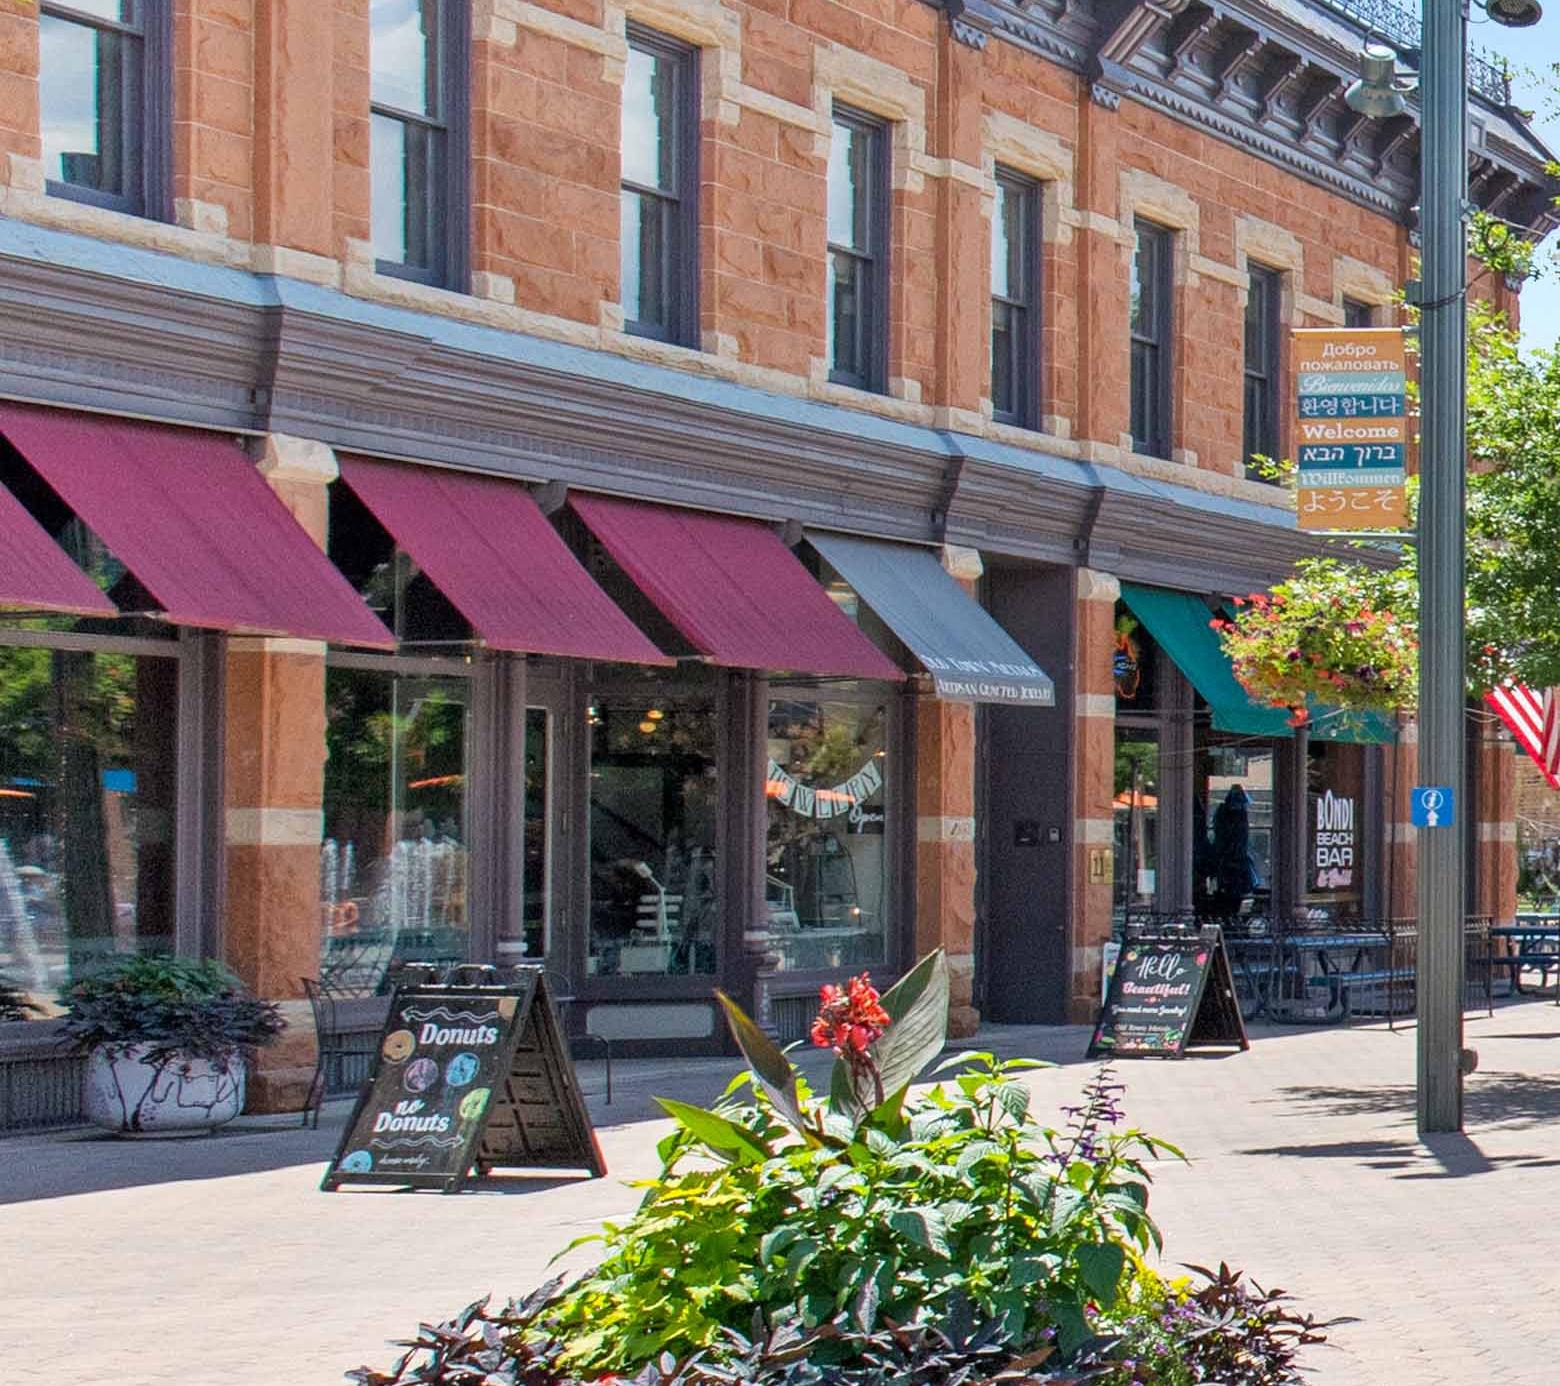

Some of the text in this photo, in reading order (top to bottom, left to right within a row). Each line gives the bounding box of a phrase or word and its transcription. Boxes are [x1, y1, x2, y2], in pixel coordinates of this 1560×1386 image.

[1321, 342, 1376, 358] Добро
[1300, 359, 1399, 371] пожаловать
[1301, 396, 1400, 416] 환영합니다
[1302, 423, 1399, 439] Welcome
[1303, 445, 1396, 467] ברוך הבא
[1303, 489, 1399, 512] ようこそ
[850, 804, 885, 834] Open
[1317, 789, 1353, 830] BONDI
[1317, 832, 1353, 845] BEACH
[1316, 847, 1353, 867] BAR
[1136, 953, 1188, 981] Hello
[1122, 980, 1192, 997] Beautiful!
[420, 1023, 498, 1046] Donuts
[395, 1099, 425, 1115] no
[373, 1112, 450, 1133] Donuts
